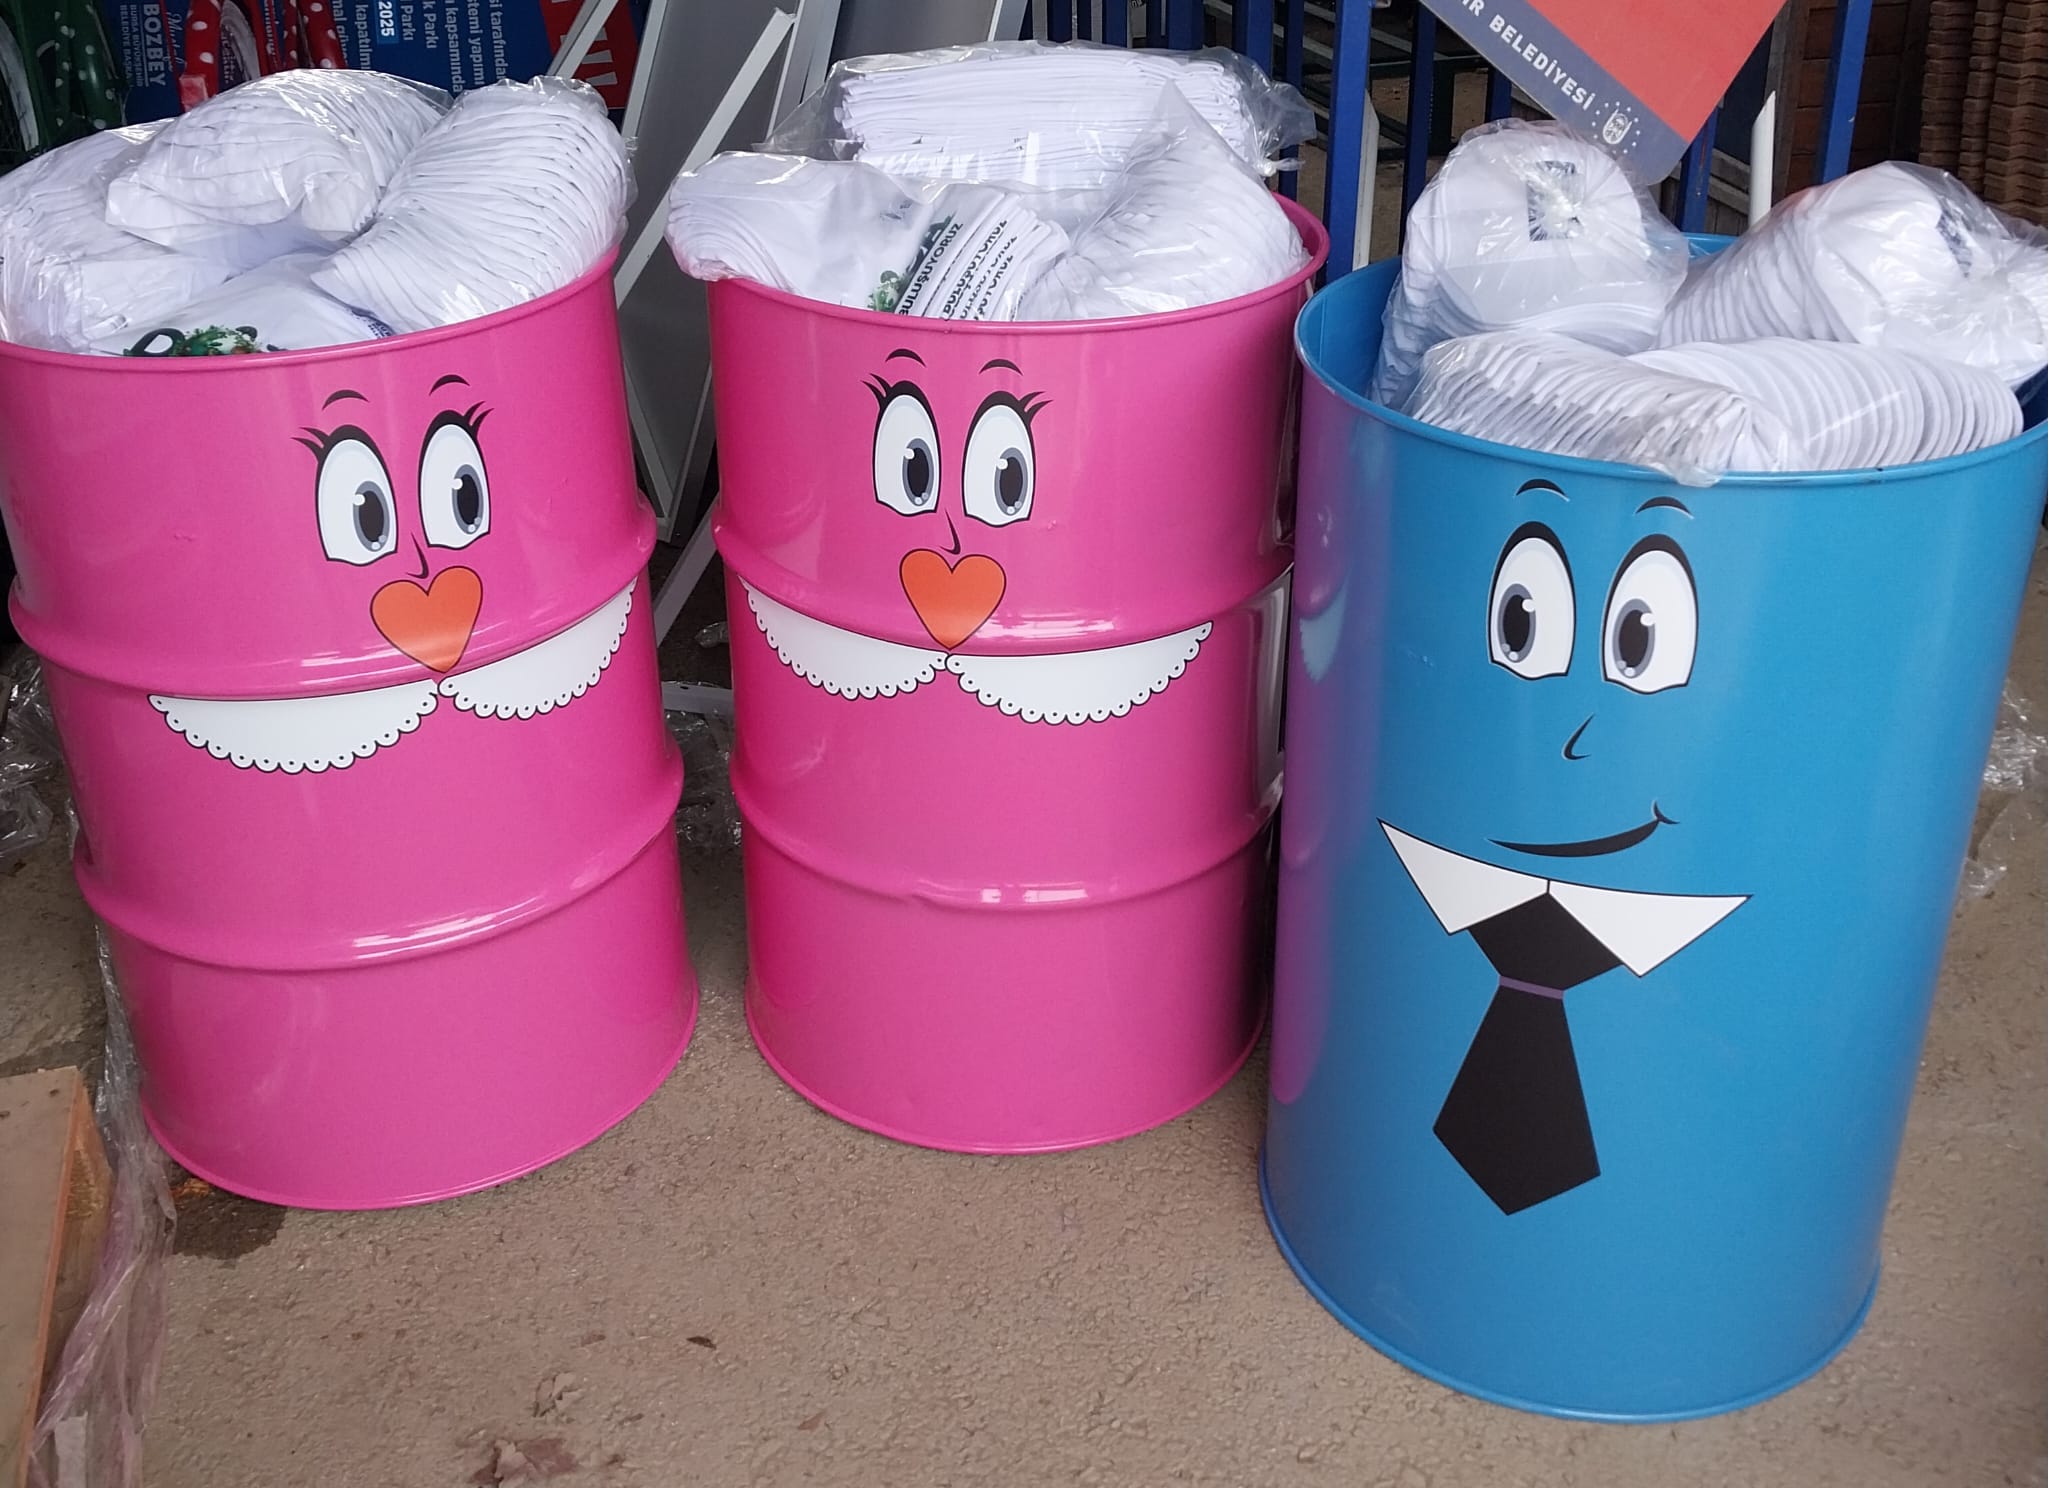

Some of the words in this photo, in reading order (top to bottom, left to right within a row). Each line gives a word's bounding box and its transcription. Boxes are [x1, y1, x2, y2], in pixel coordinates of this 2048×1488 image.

[119, 5, 132, 48] BELEDİYE
[129, 4, 140, 33] BURSA
[378, 1, 395, 36] 2025
[400, 5, 416, 41] Parkı
[423, 13, 439, 48] Parkı
[143, 3, 167, 87] BOZBEY
[444, 8, 465, 92] kapsamında
[468, 37, 486, 85] yapımı
[1489, 14, 1597, 111] BELEDİYESİ
